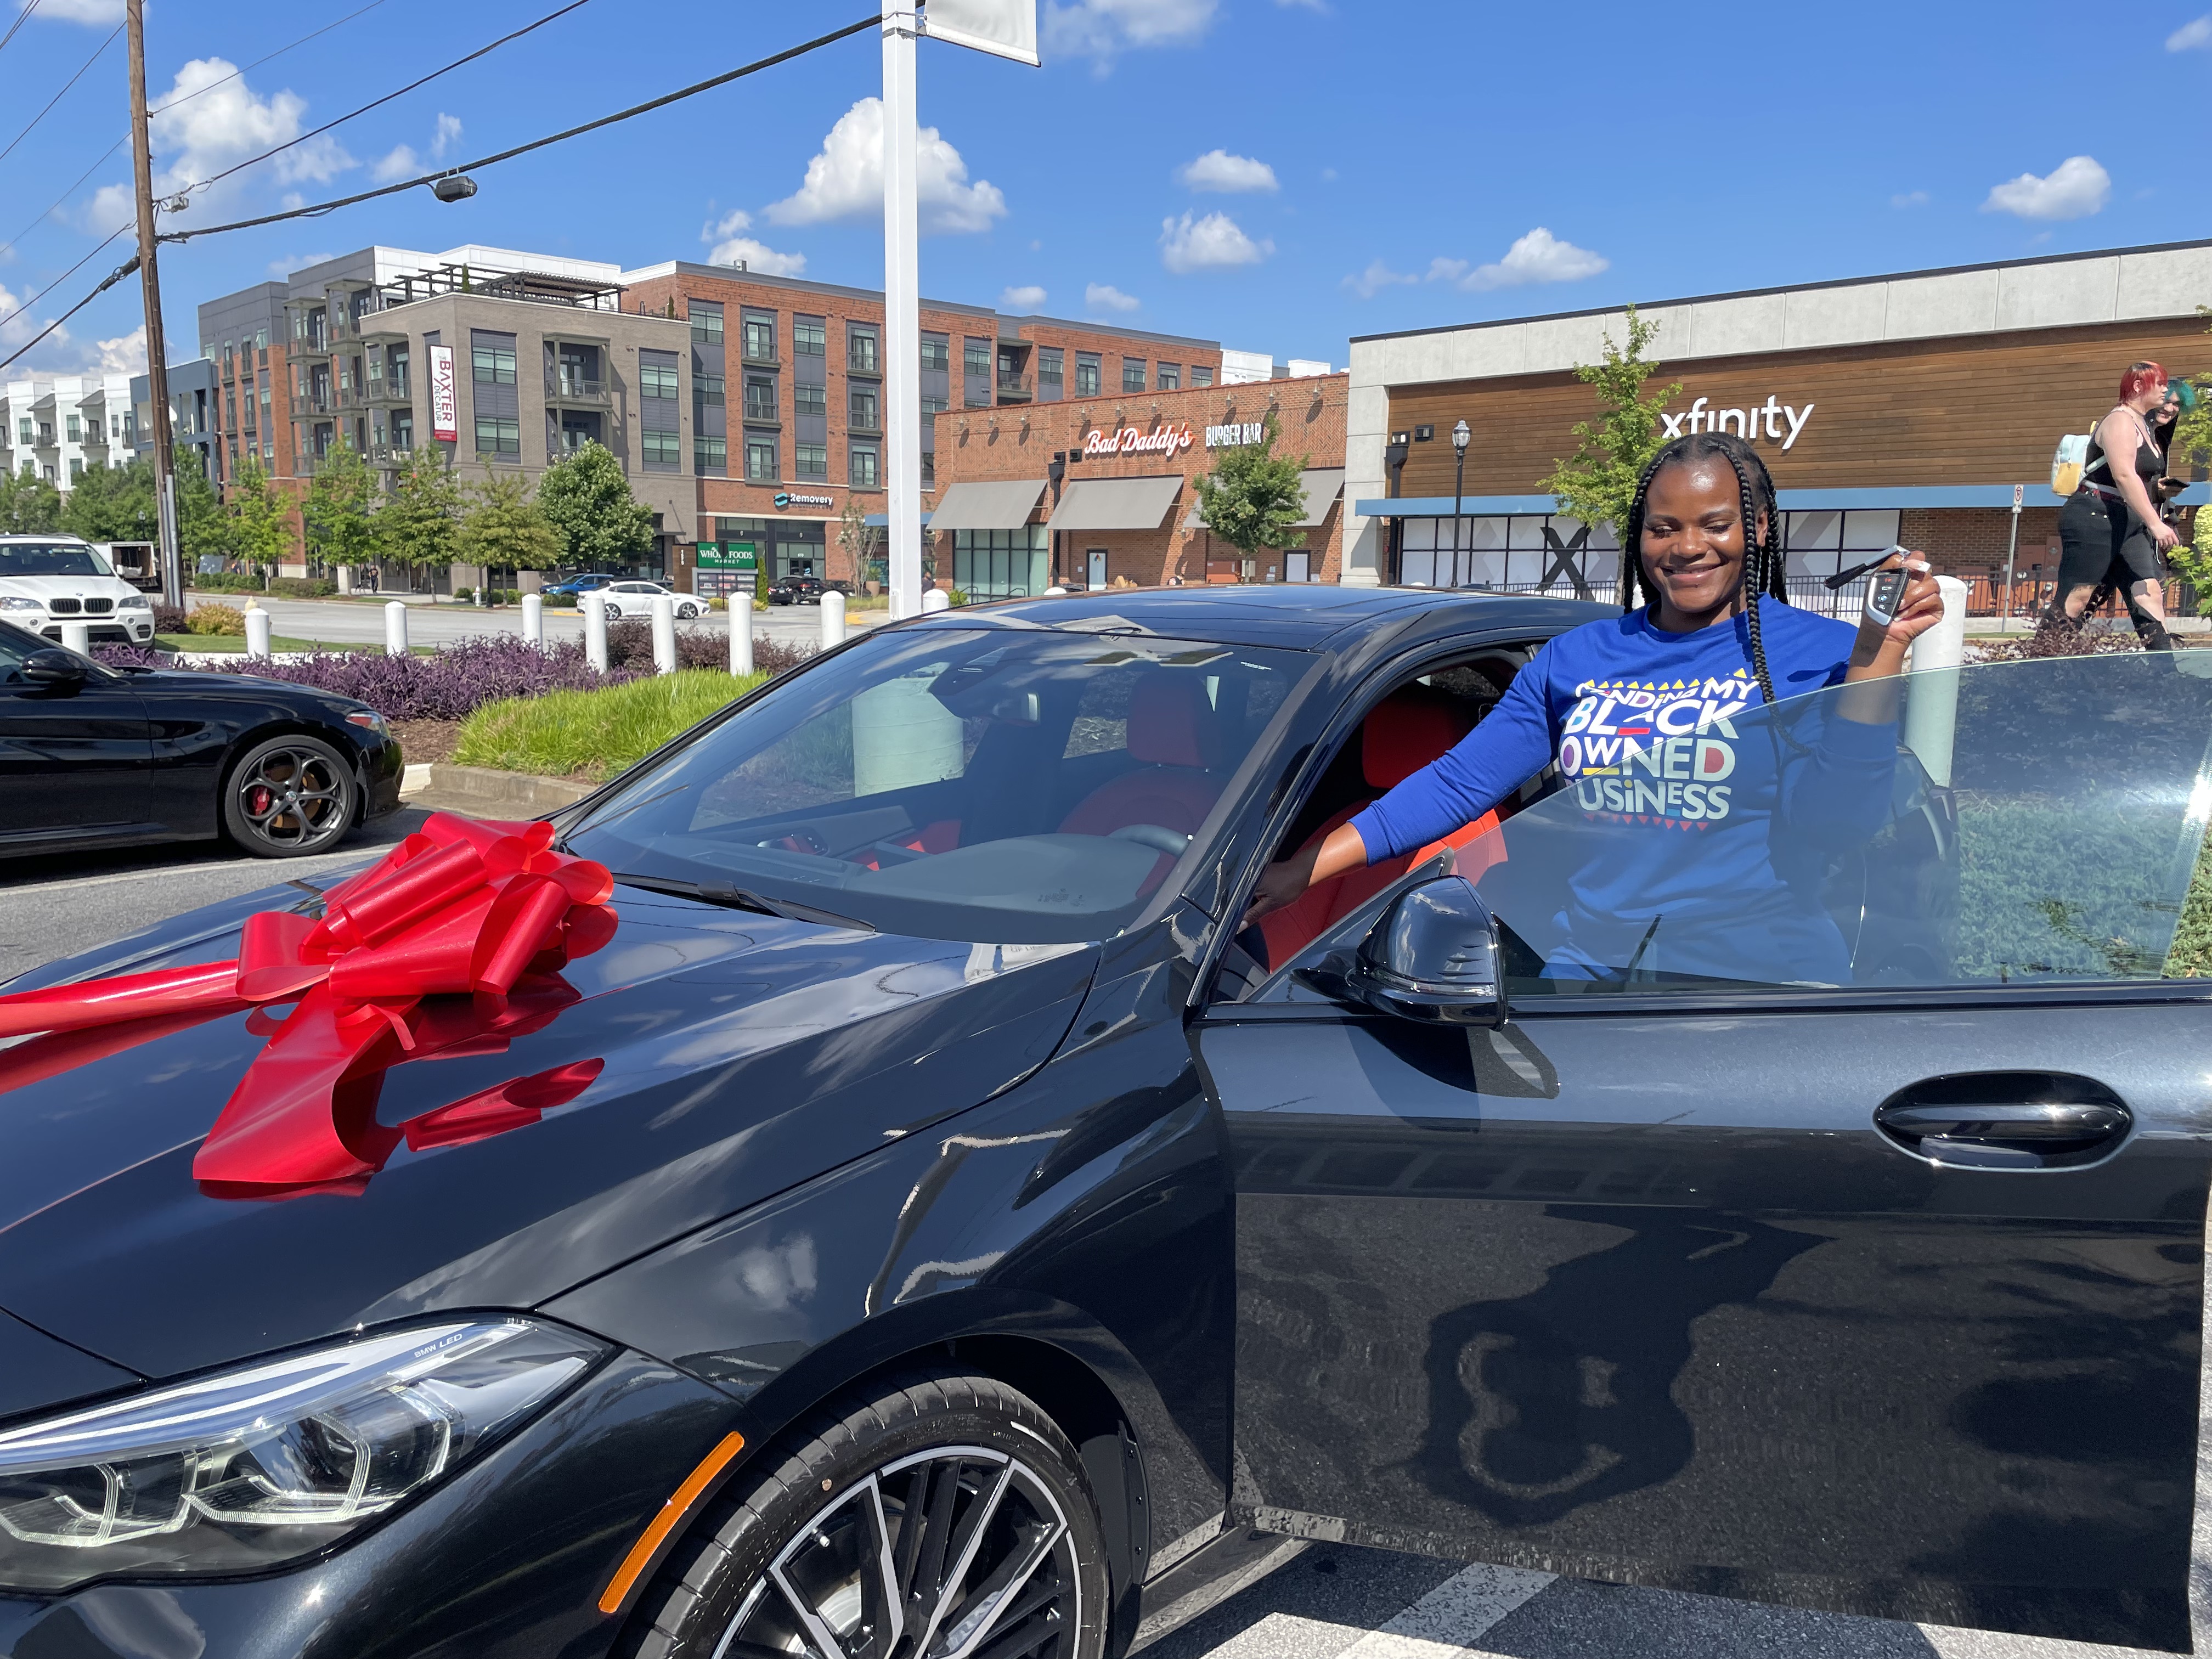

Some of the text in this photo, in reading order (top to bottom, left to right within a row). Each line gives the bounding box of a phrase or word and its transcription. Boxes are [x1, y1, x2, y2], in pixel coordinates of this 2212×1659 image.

[434, 360, 453, 422] BAXTER
[434, 385, 442, 421] DECATUR
[1085, 422, 1194, 456] Bad Daddy's
[1206, 422, 1261, 447] BURGER BAR
[1660, 394, 1815, 450] xfinity
[790, 493, 833, 505] Removery
[700, 550, 753, 559] WHO FOODS
[1701, 679, 1759, 700] MY
[1564, 696, 1747, 740] BLACK
[1560, 736, 1736, 782] OWNED
[414, 1333, 463, 1358] BMW LED
